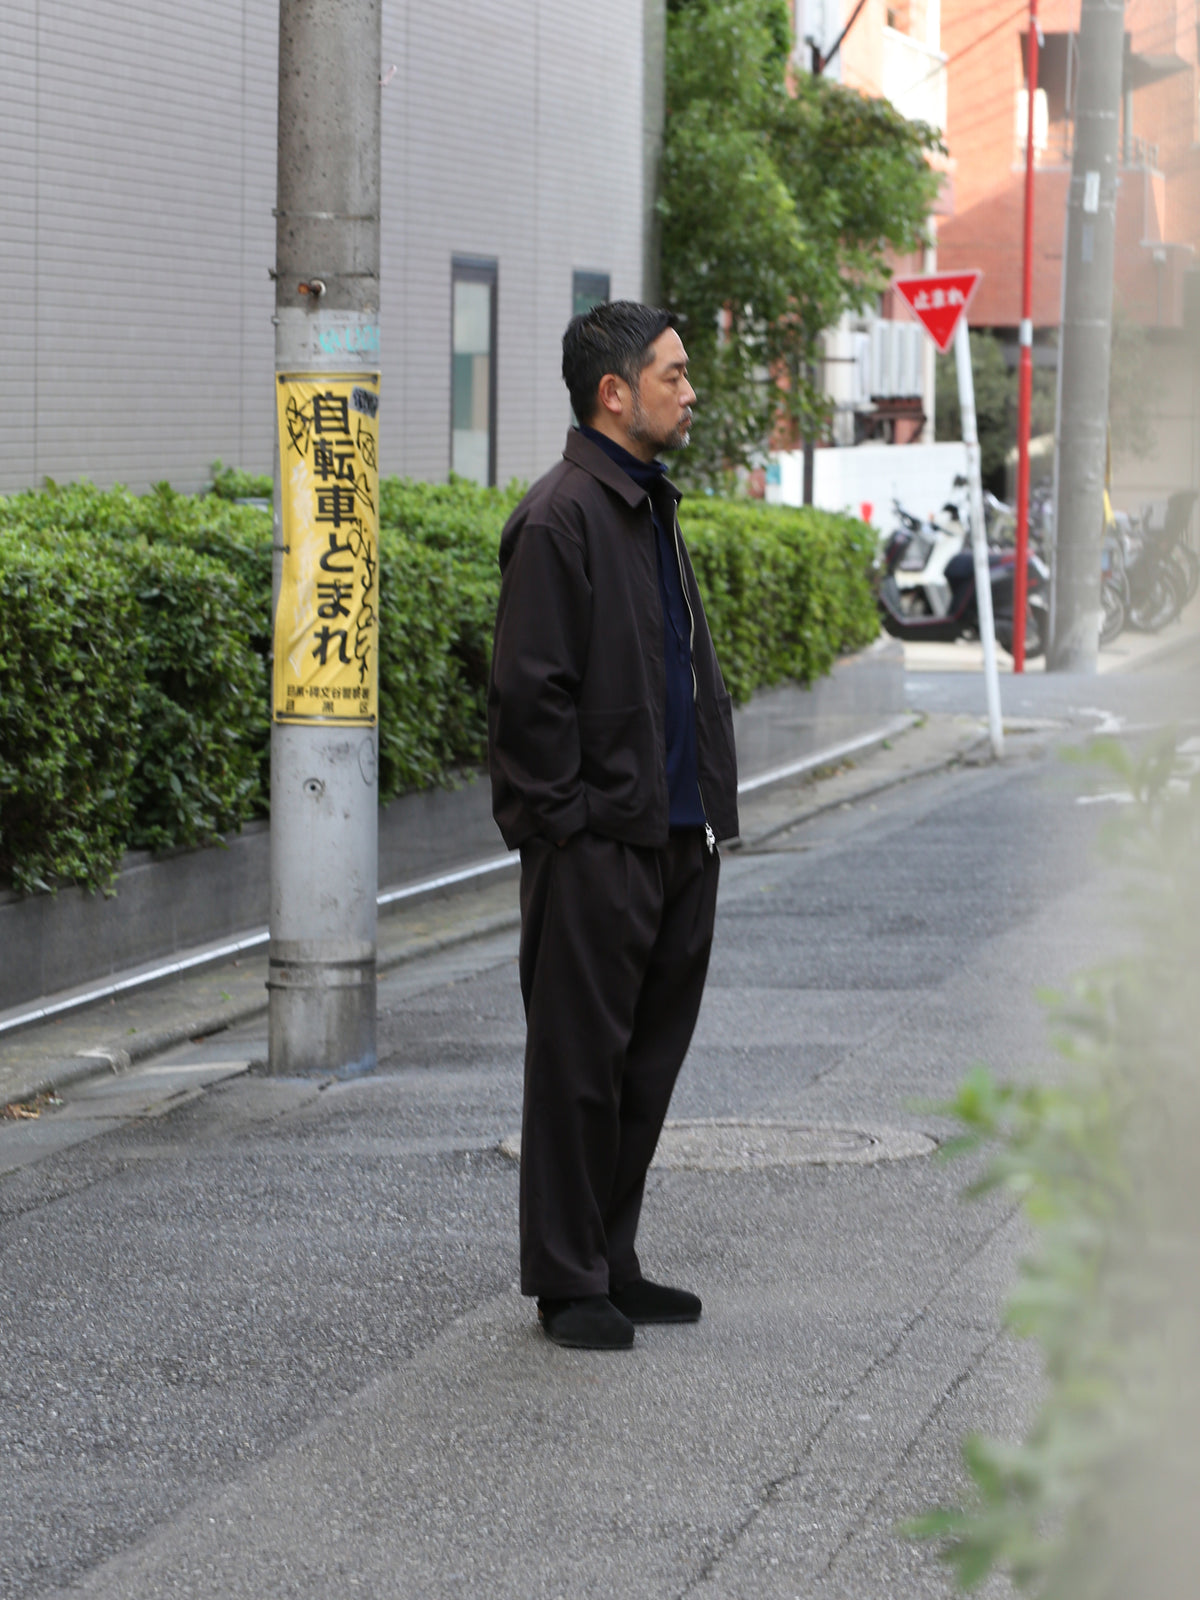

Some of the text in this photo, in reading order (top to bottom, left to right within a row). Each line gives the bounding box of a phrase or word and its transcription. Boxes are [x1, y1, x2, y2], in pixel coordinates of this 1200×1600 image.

[914, 287, 965, 310] 止まれ
[312, 391, 358, 665] 自転車とまれ
